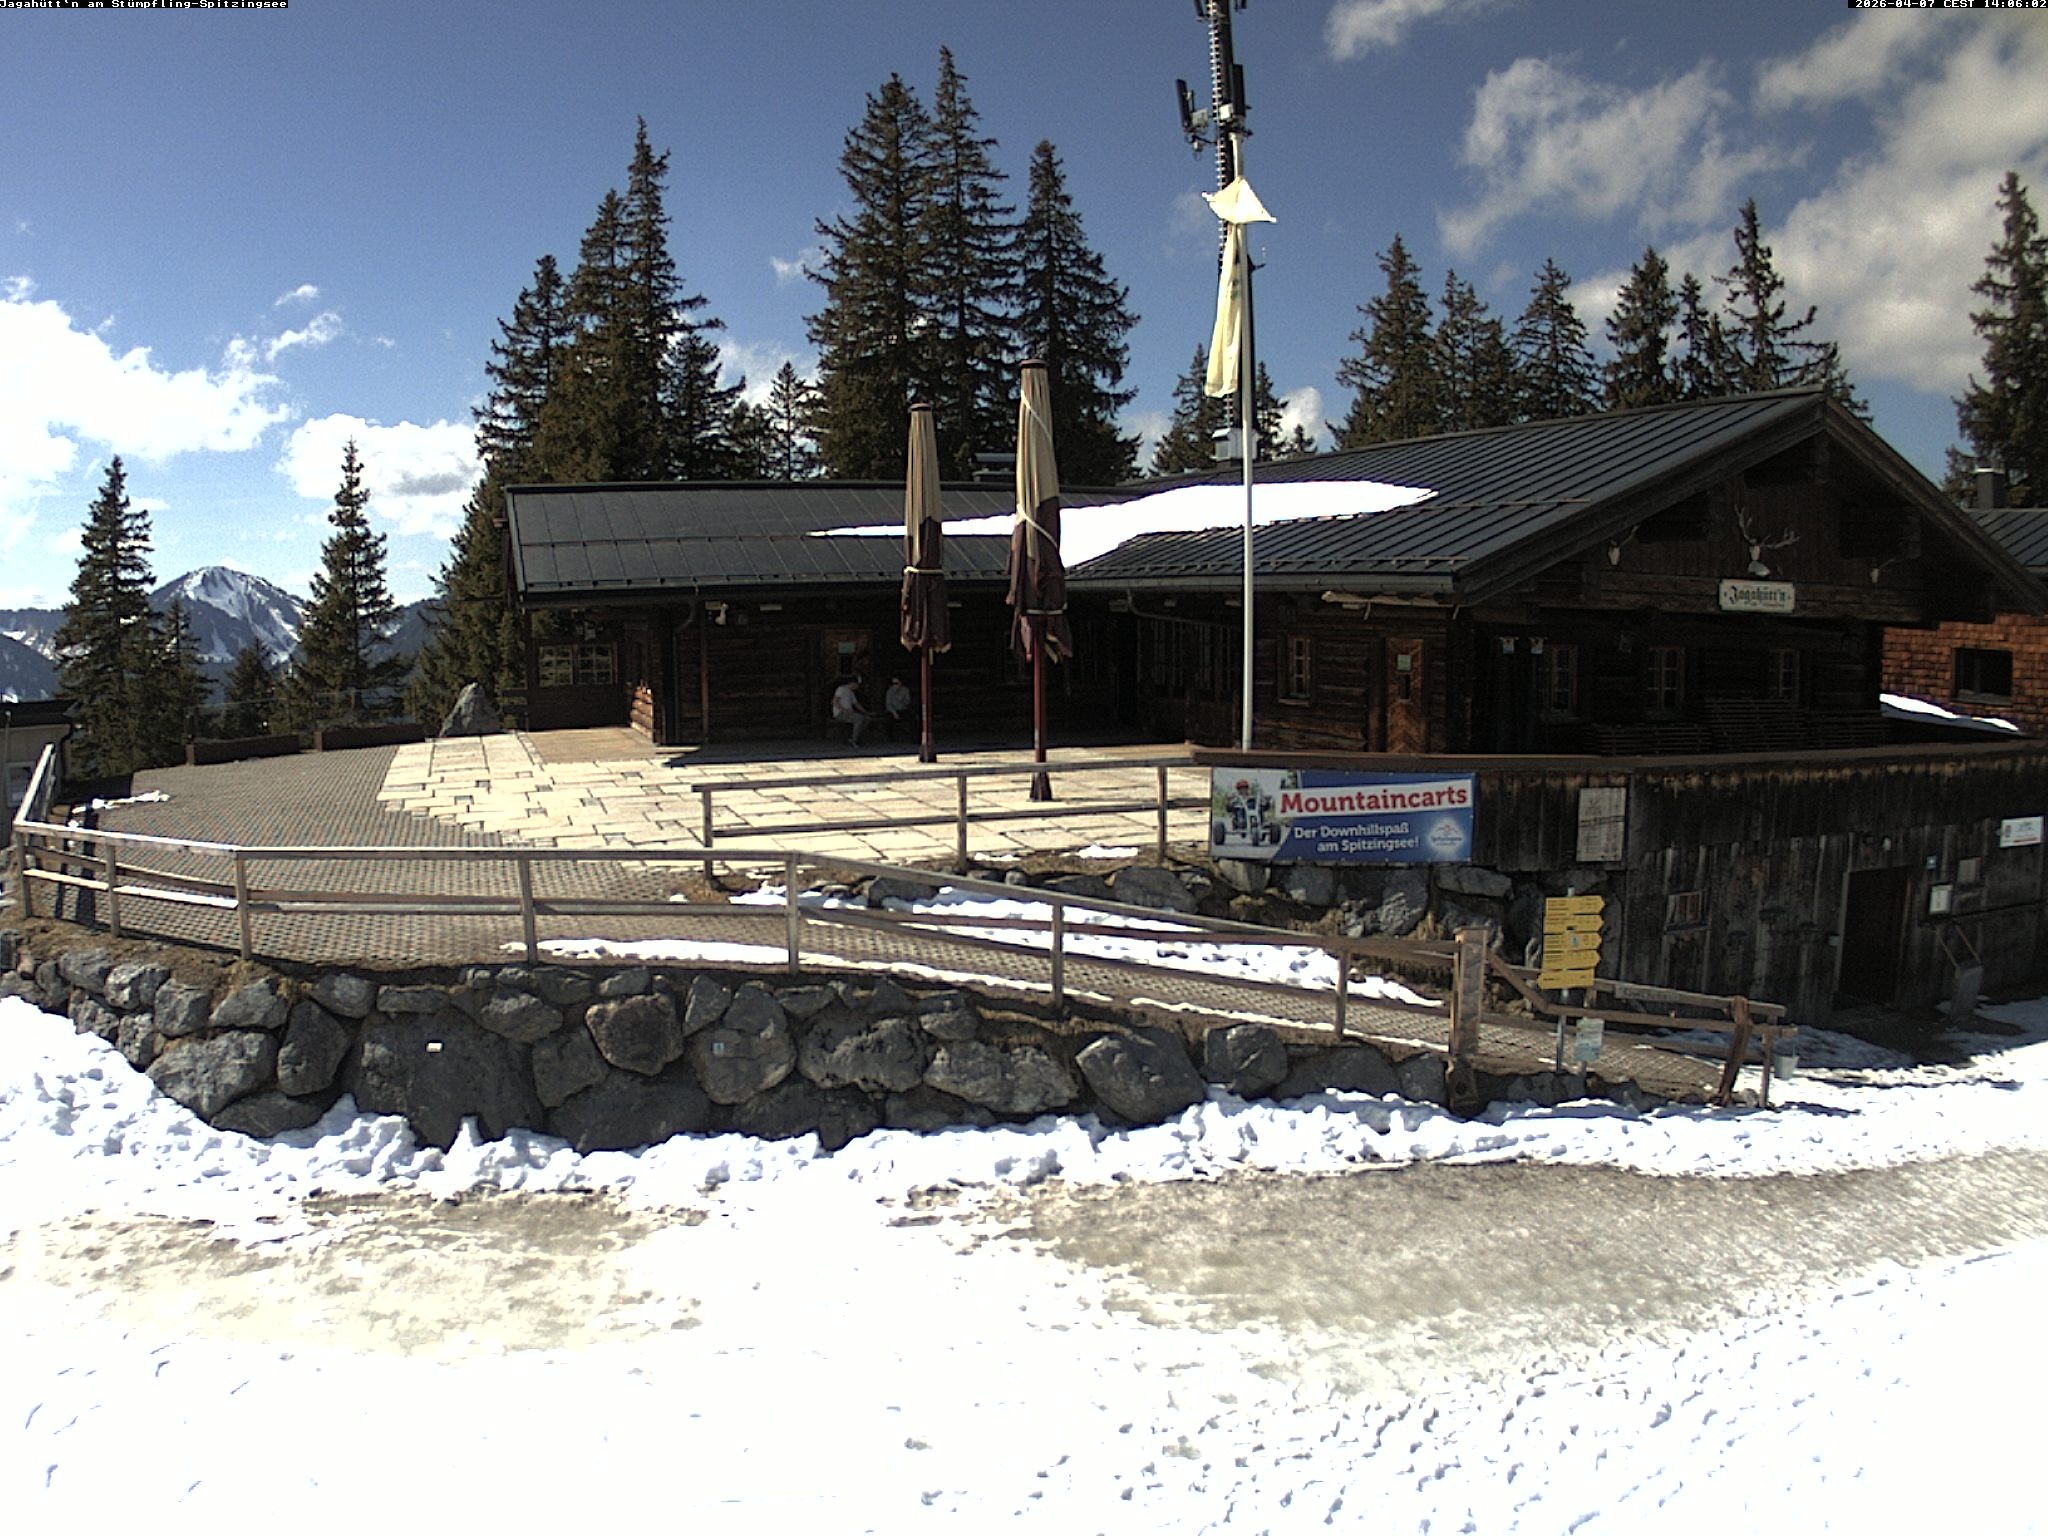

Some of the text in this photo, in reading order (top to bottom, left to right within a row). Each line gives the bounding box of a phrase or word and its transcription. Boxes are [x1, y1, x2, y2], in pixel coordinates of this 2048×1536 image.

[1280, 786, 1467, 813] Mountaincarts
[1294, 821, 1409, 838] Der Downhillspaß
[1317, 841, 1339, 852] am
[1341, 836, 1419, 854] Spitzingsee!
